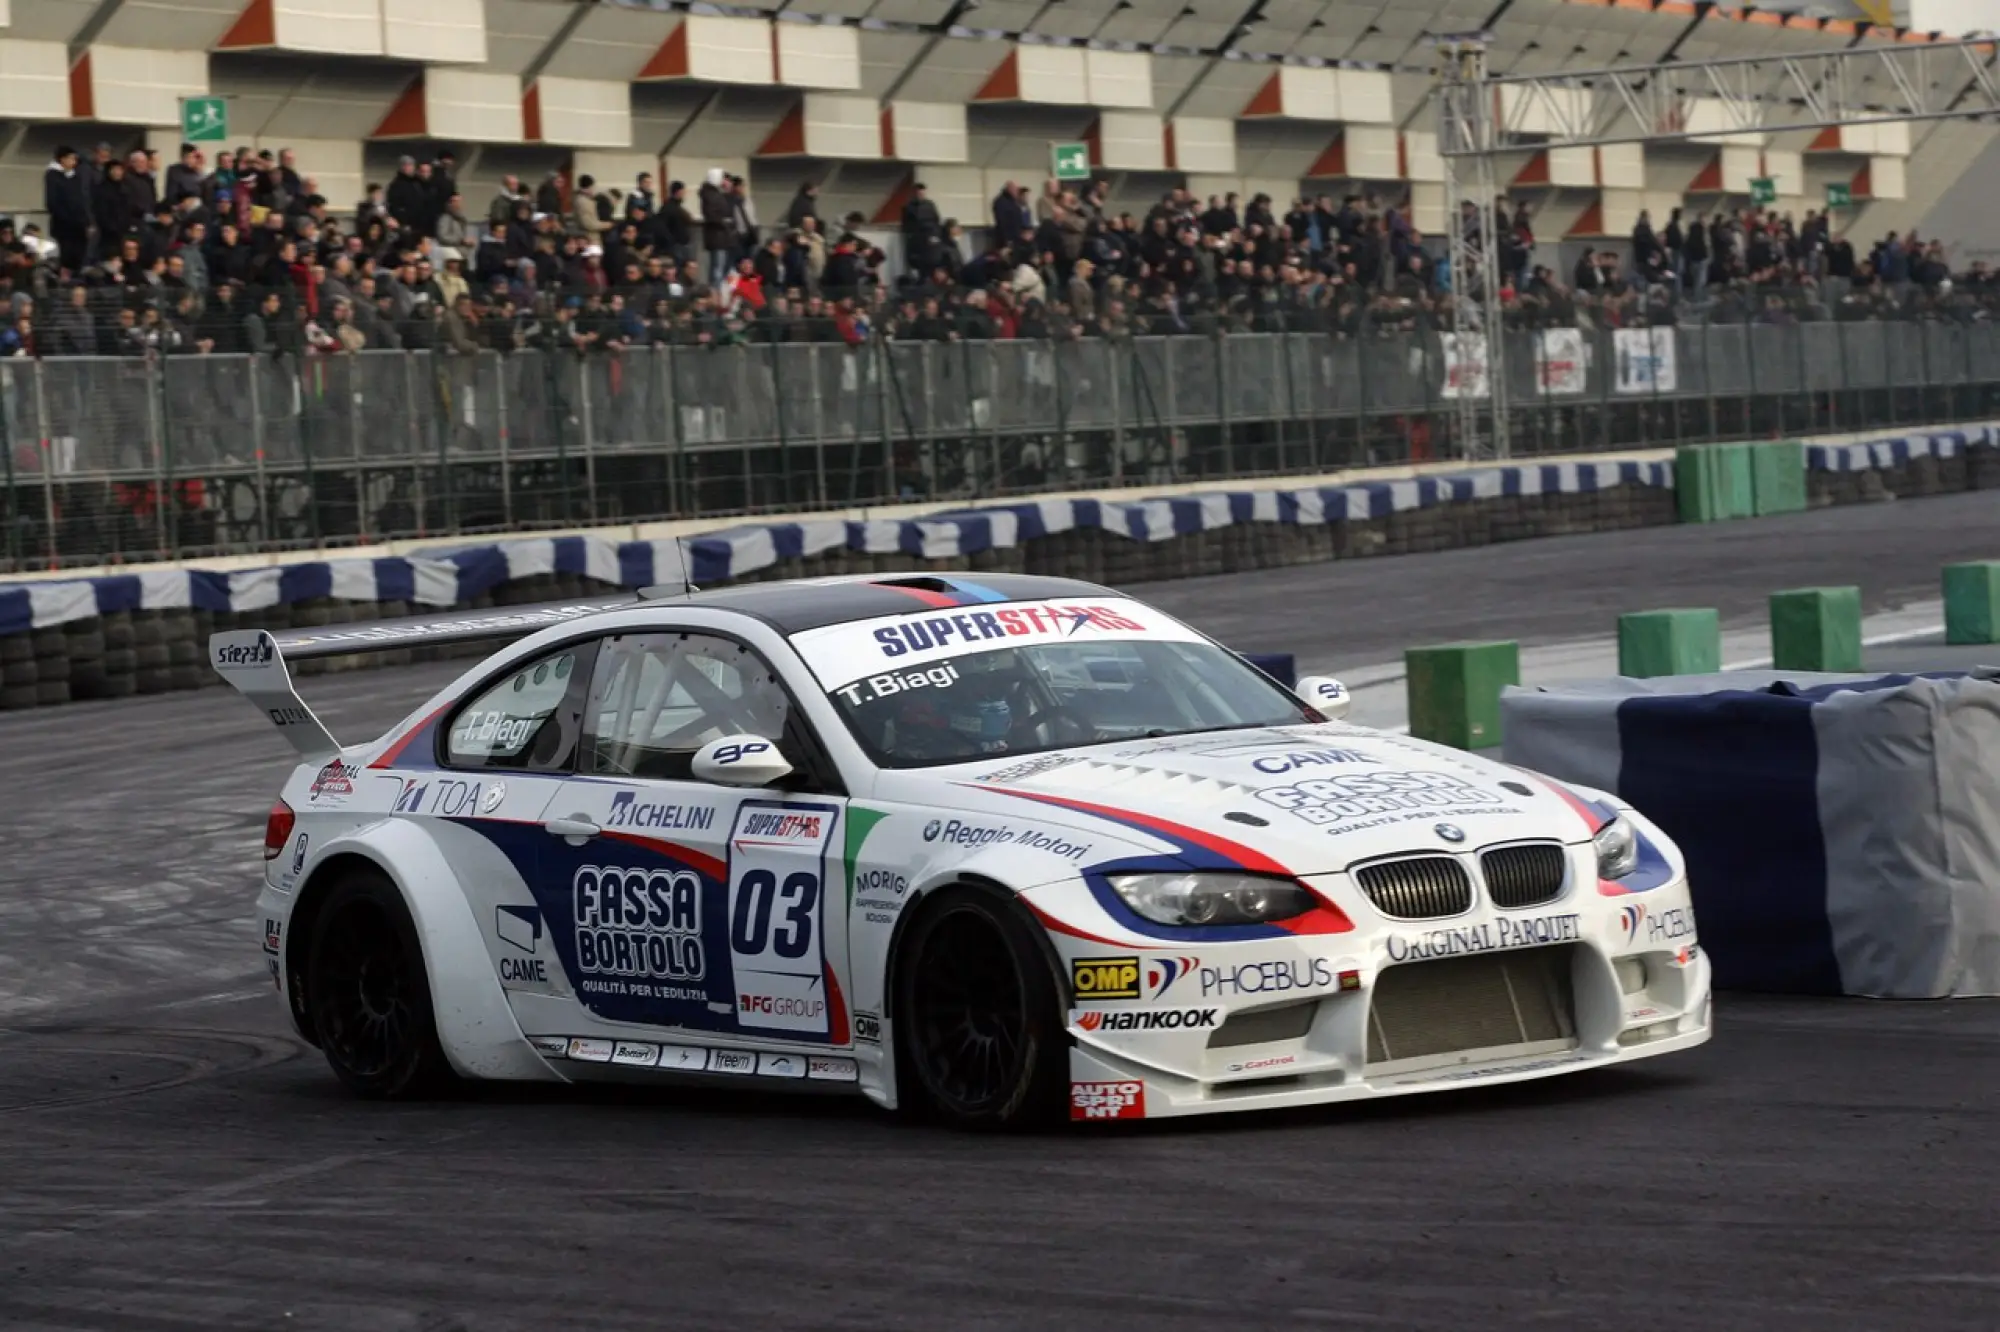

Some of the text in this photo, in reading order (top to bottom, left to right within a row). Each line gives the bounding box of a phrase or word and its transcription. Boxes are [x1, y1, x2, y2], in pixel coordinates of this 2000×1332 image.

[836, 660, 960, 706] T.Biagi
[463, 711, 535, 750] T.Biagi
[1252, 749, 1382, 774] CAME
[430, 779, 482, 816] TOA
[942, 819, 1093, 860] Reggio Motori
[574, 866, 701, 934] FASSA
[731, 869, 818, 958] 03
[500, 957, 548, 982] CAME
[576, 928, 705, 980] BORTOLO
[630, 984, 651, 997] PER
[1074, 966, 1139, 991] OMP
[774, 997, 824, 1018] GROUP
[1245, 1055, 1296, 1069] Castrol
[1072, 1083, 1141, 1096] AUTO
